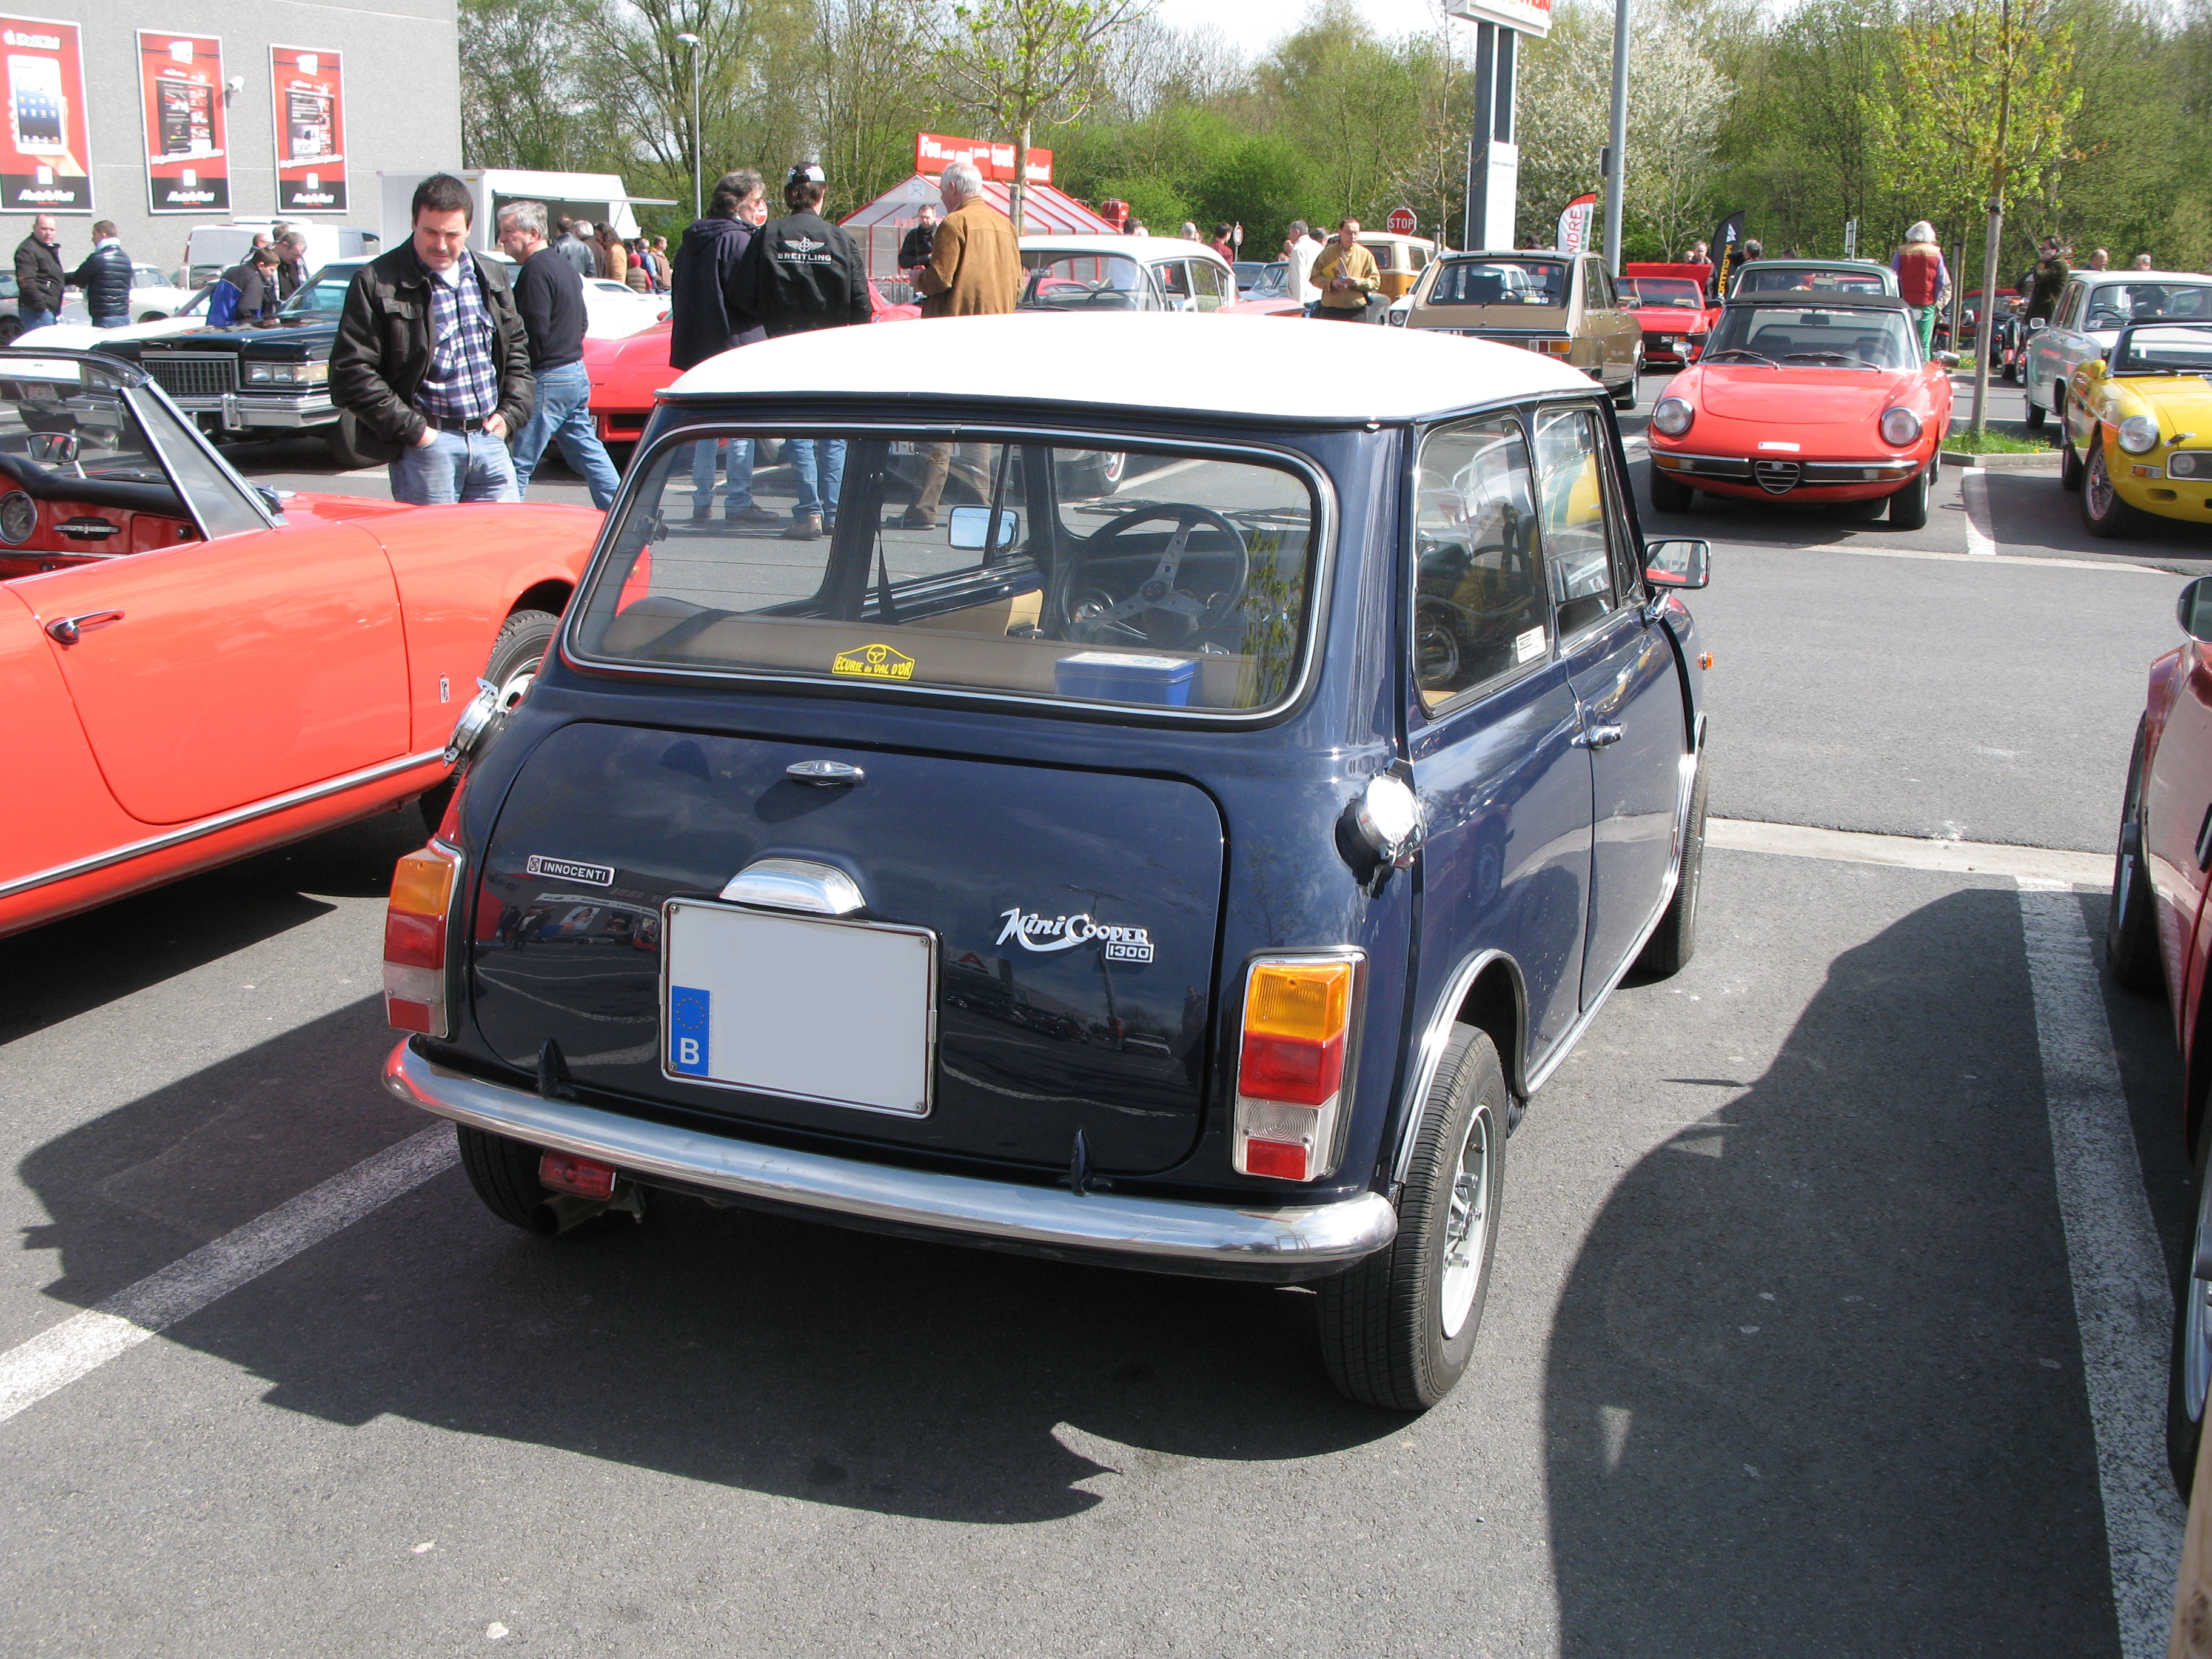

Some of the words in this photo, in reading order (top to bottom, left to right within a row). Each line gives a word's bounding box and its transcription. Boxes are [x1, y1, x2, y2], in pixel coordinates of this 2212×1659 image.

[920, 136, 941, 158] Fou
[991, 144, 1014, 167] tout
[1389, 218, 1413, 229] STOP
[1566, 210, 1583, 251] NDRE
[777, 252, 832, 261] BREITLING
[835, 656, 864, 672] ECURIE
[874, 664, 890, 674] VAL
[891, 662, 912, 676] D'OR
[543, 862, 606, 881] INNOCENTI
[995, 907, 1076, 952] Mini
[1110, 945, 1150, 959] 1300
[680, 1037, 700, 1065] B
